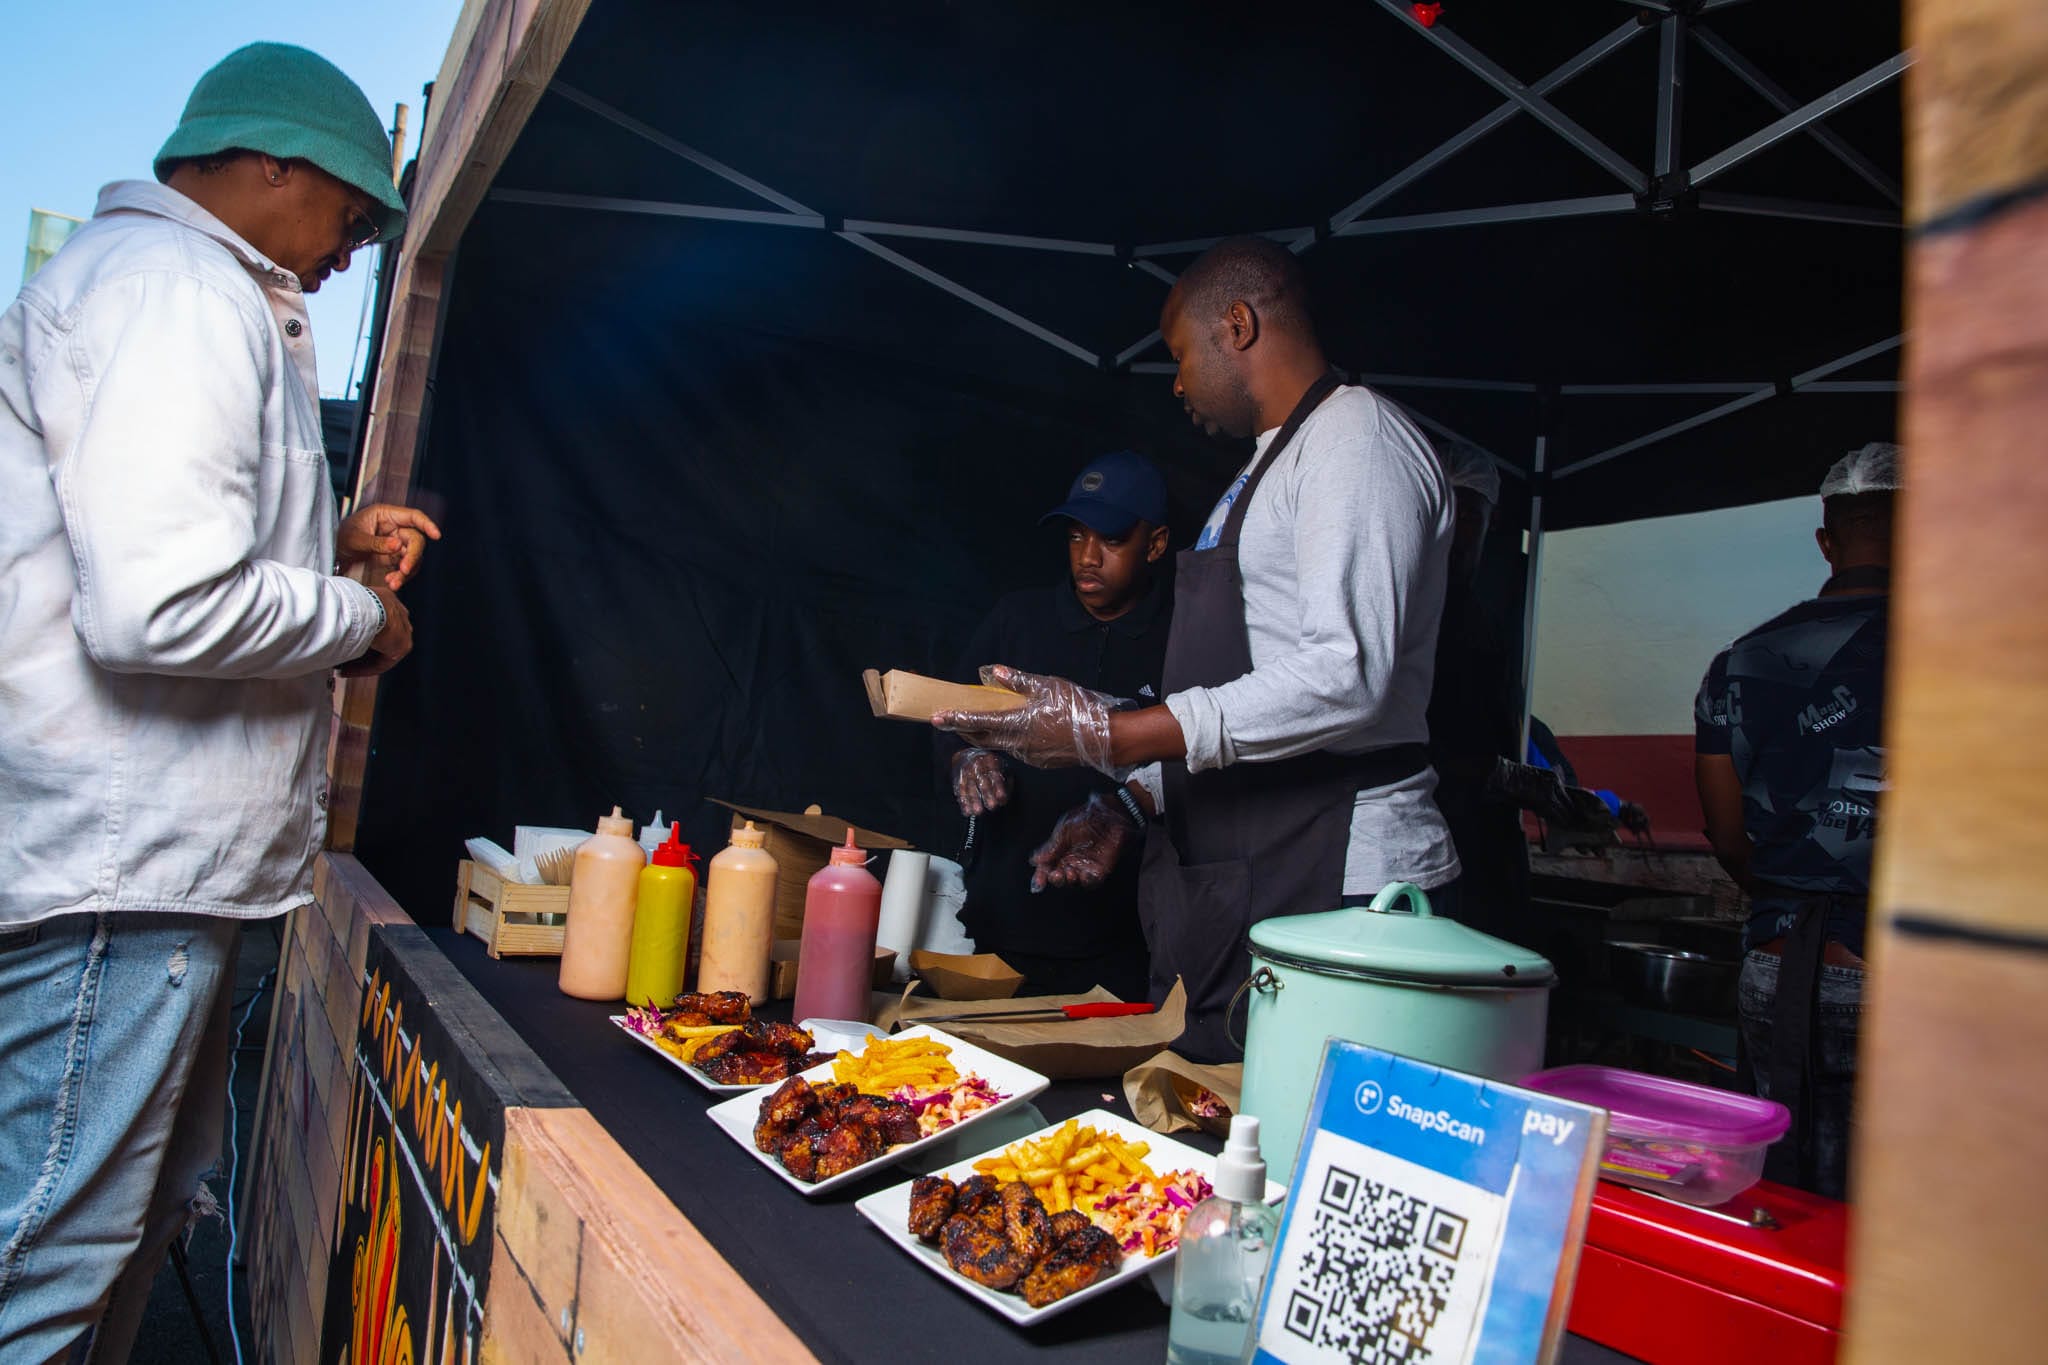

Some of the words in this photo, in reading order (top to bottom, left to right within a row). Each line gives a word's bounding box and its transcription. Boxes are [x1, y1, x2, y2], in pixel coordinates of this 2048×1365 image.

[1812, 710, 1847, 733] SHOW
[1386, 1094, 1486, 1146] SnapScan
[1522, 1109, 1575, 1145] pay
